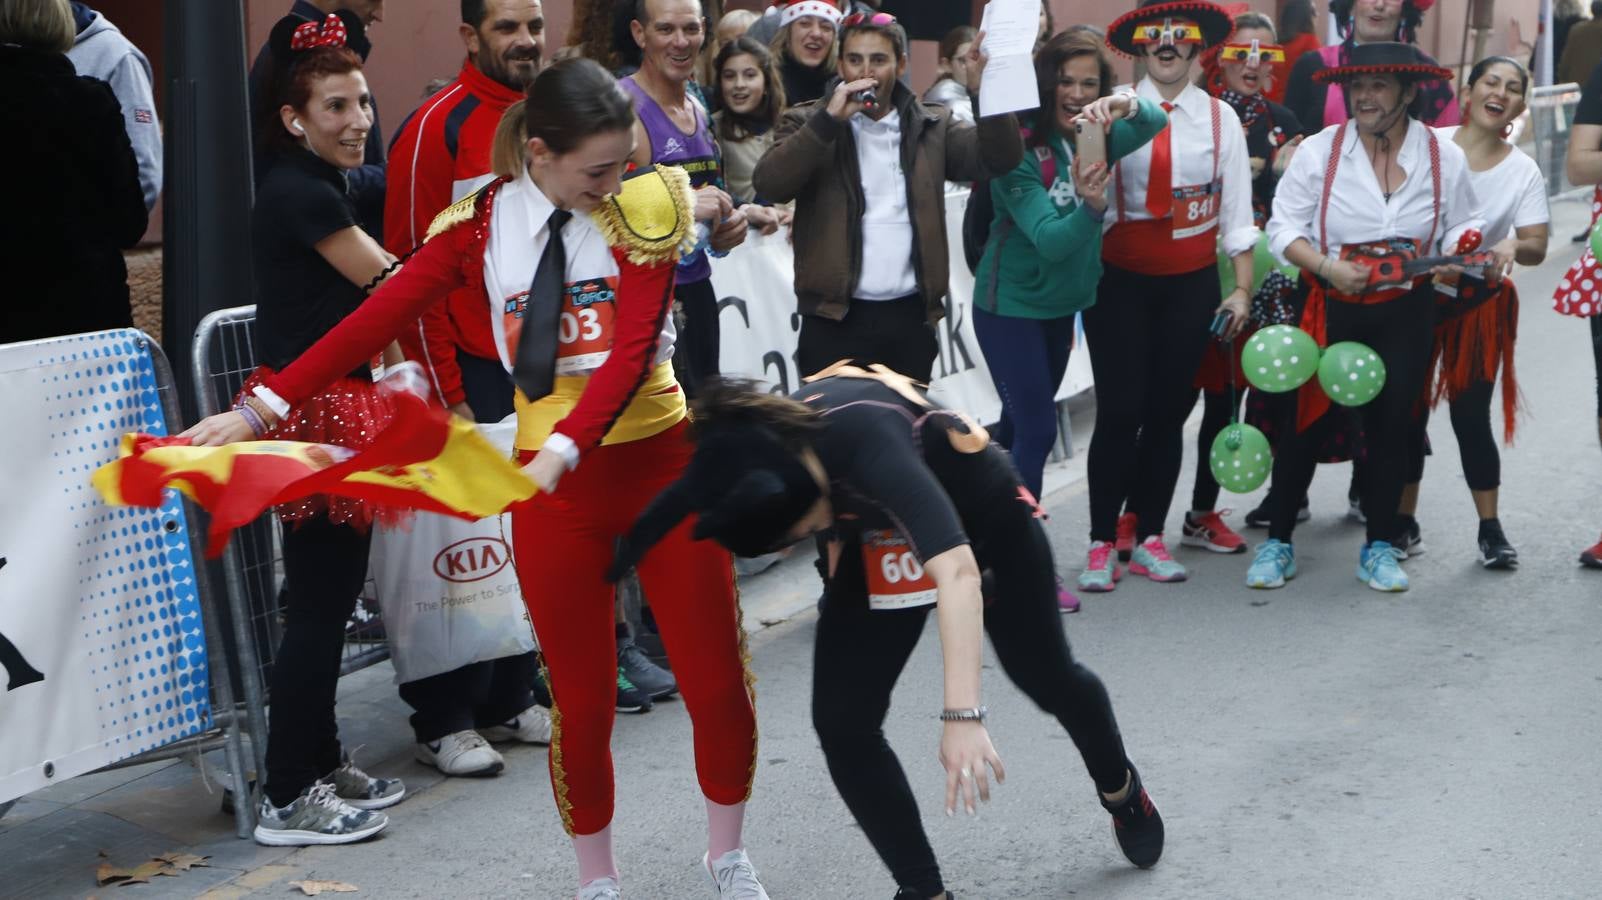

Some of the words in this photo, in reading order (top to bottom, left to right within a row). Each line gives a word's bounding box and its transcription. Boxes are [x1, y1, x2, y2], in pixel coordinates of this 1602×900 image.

[1187, 196, 1214, 220] 841
[445, 544, 501, 576] KIA
[415, 600, 438, 613] The
[440, 593, 478, 609] Power
[481, 589, 495, 601] to
